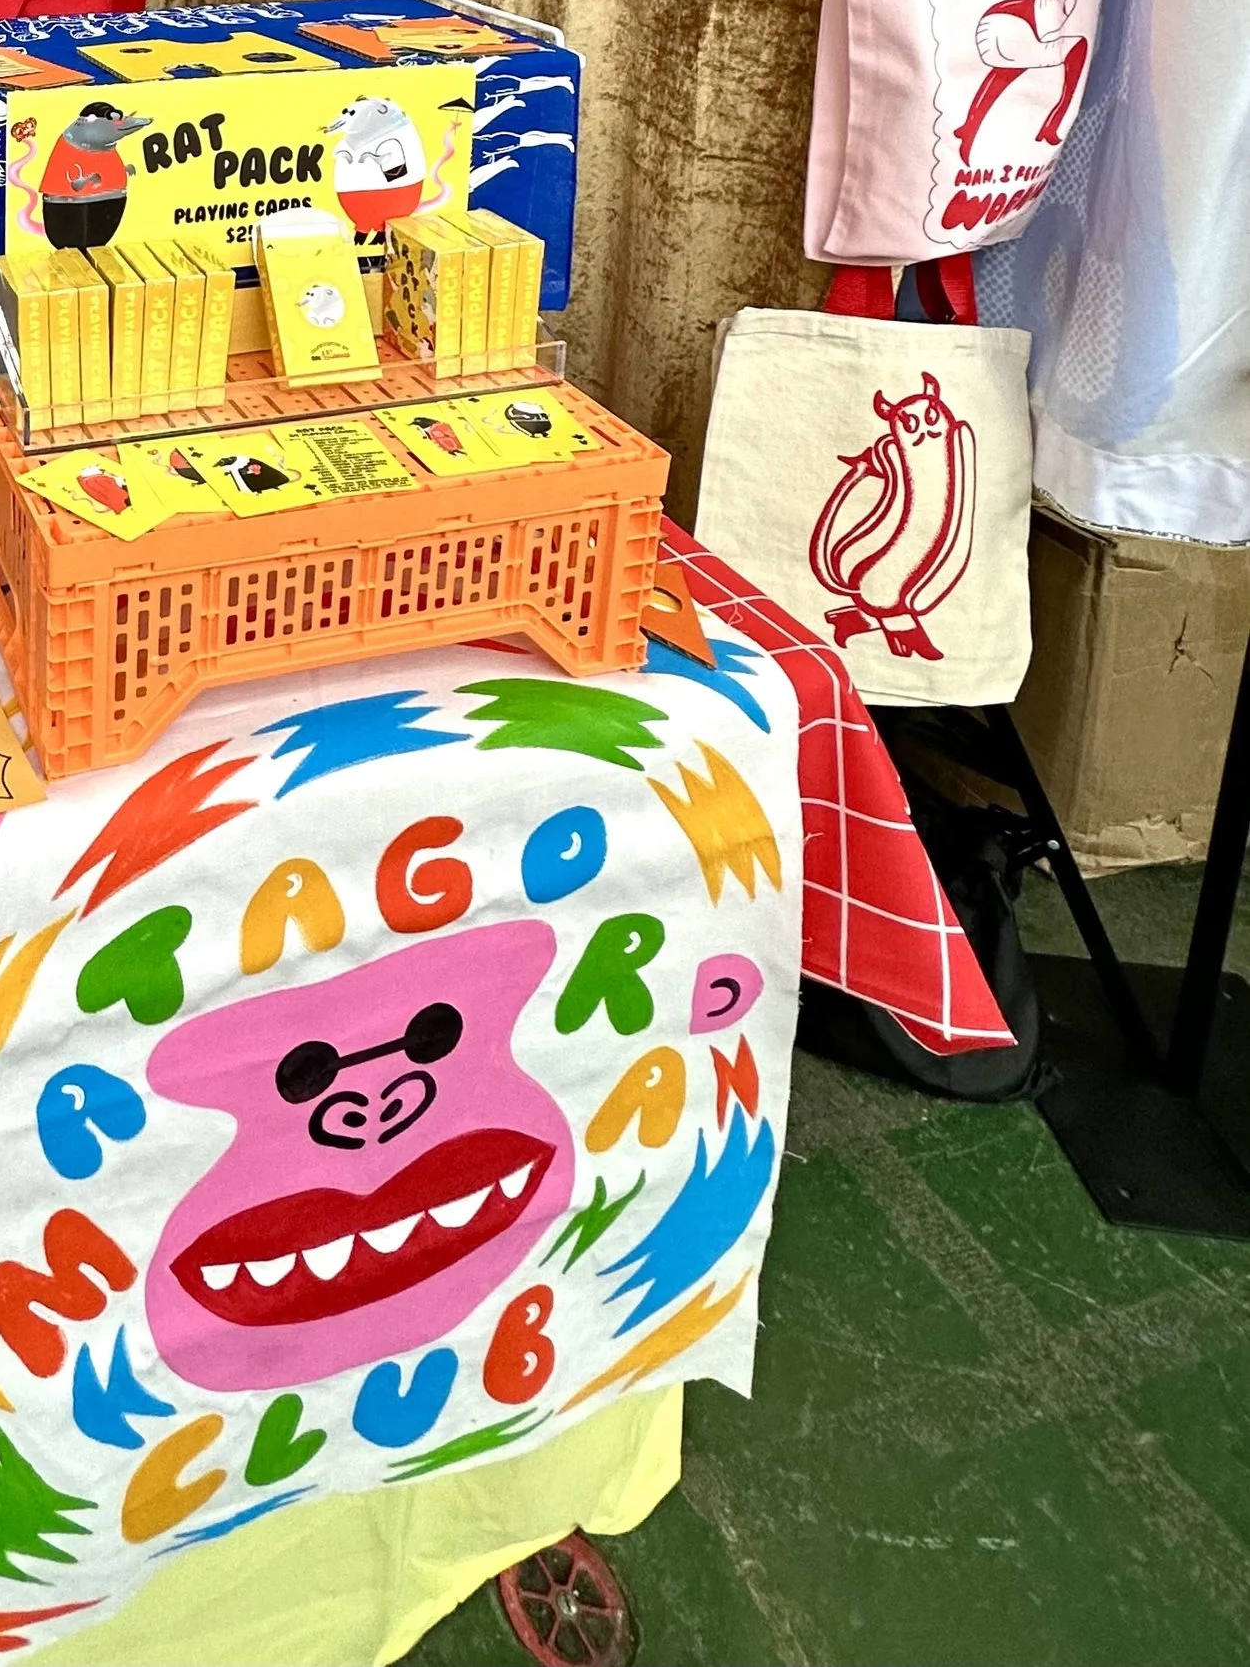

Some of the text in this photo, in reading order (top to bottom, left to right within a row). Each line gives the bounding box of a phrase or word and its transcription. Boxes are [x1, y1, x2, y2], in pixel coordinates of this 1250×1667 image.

[142, 113, 225, 173] RAT
[214, 144, 324, 189] PACK
[1000, 165, 1013, 183] I
[174, 202, 249, 225] PLAYING
[150, 296, 168, 351] PACK
[178, 292, 198, 347] PACK
[208, 288, 227, 343] PACK
